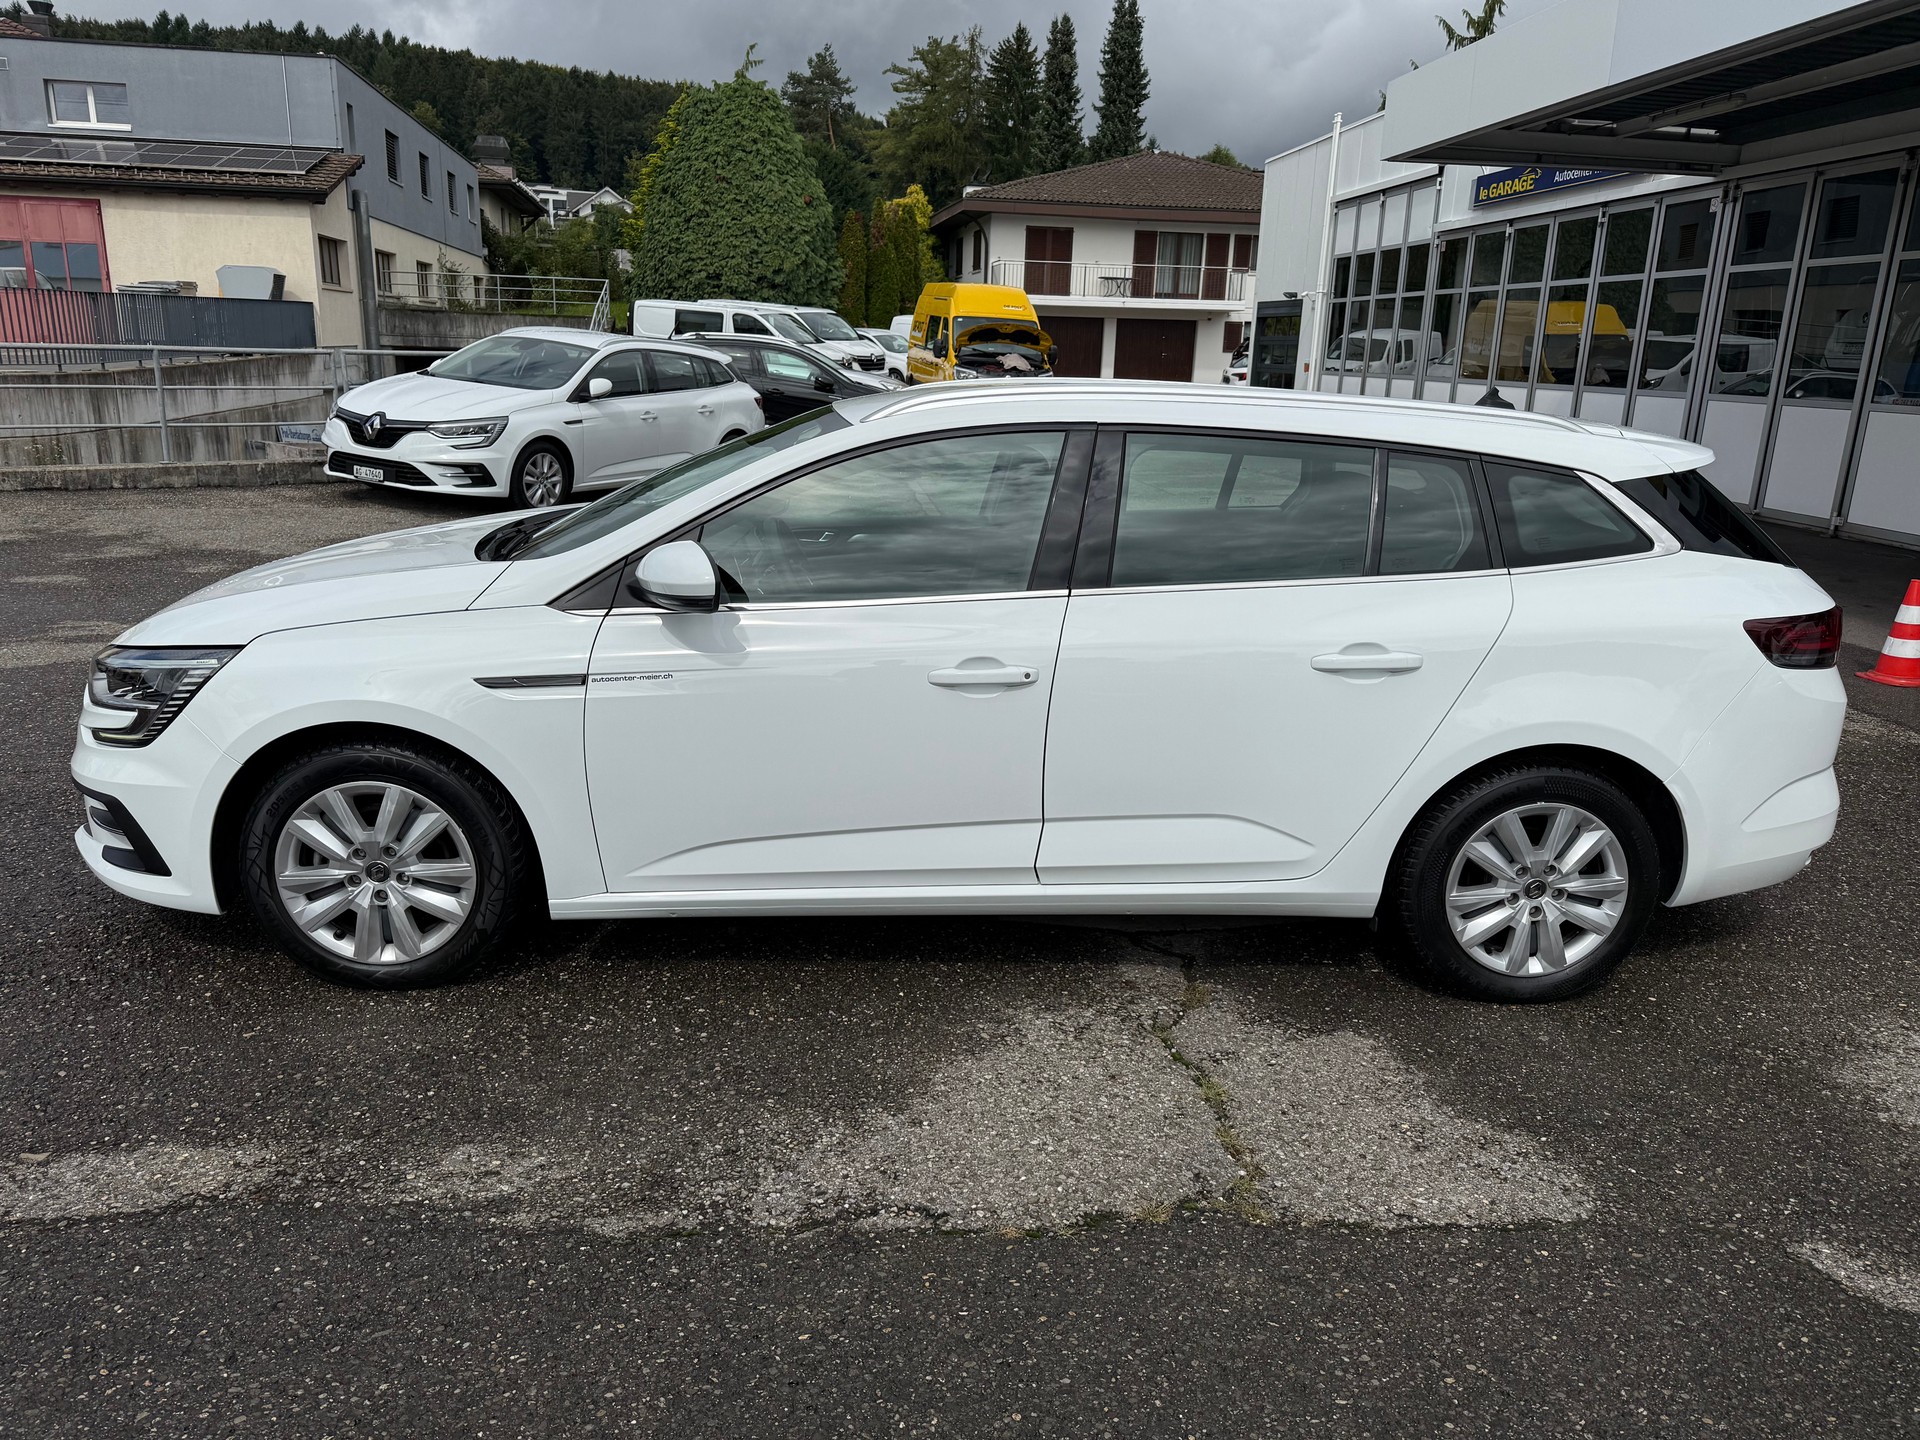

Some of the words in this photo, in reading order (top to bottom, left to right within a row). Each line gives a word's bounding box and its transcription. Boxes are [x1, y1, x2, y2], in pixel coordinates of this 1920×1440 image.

[1479, 186, 1488, 200] le
[1489, 174, 1535, 198] GARAGE
[591, 673, 673, 683] autocenter-meier.ch
